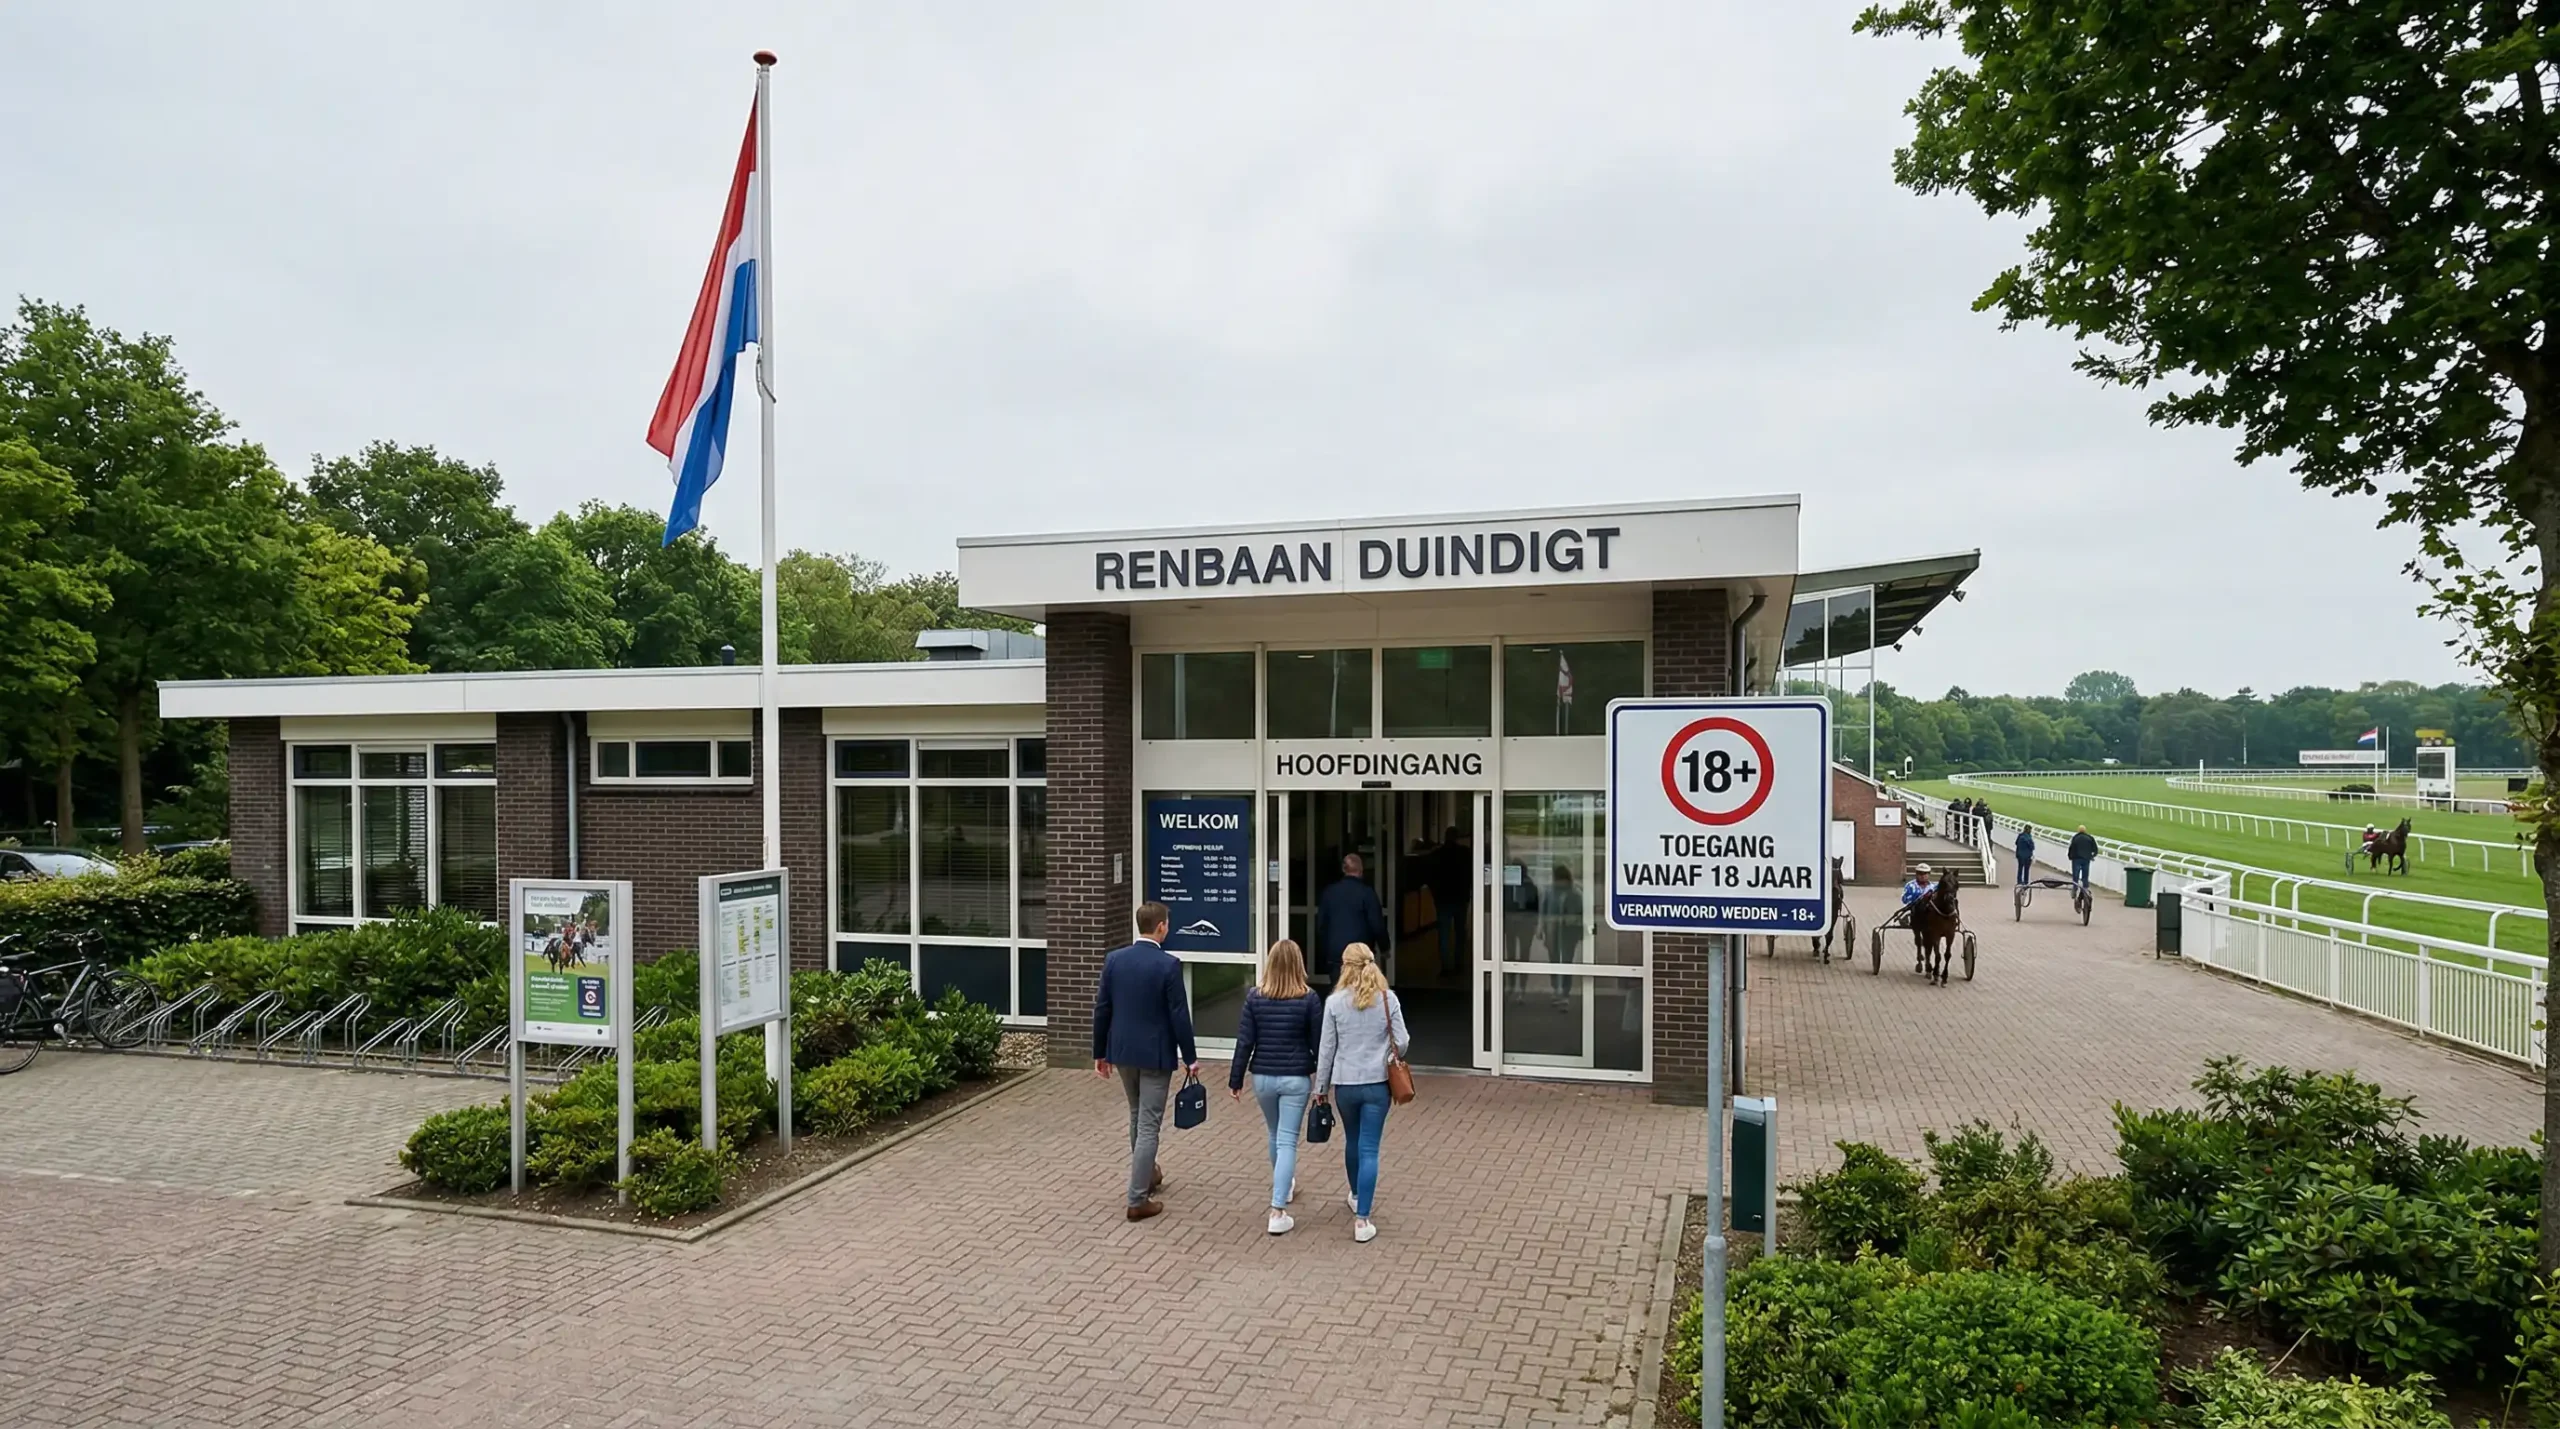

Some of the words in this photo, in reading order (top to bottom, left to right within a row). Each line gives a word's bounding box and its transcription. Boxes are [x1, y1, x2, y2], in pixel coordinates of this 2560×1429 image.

[1095, 542, 1332, 590] RENBAAN
[1358, 527, 1621, 580] DUINDIGT
[1276, 753, 1483, 776] HOOFDINGANG
[1681, 750, 1757, 793] 18+
[1159, 813, 1239, 830] WELKOM
[1660, 834, 1775, 858] TOEGANG
[1623, 863, 1702, 887] VANAF
[1711, 865, 1739, 888] 18
[1747, 866, 1812, 889] JAAR
[1619, 903, 1718, 920] VERANTWOORD
[1721, 905, 1778, 921] WEDDEN
[1790, 908, 1816, 922] 18+
